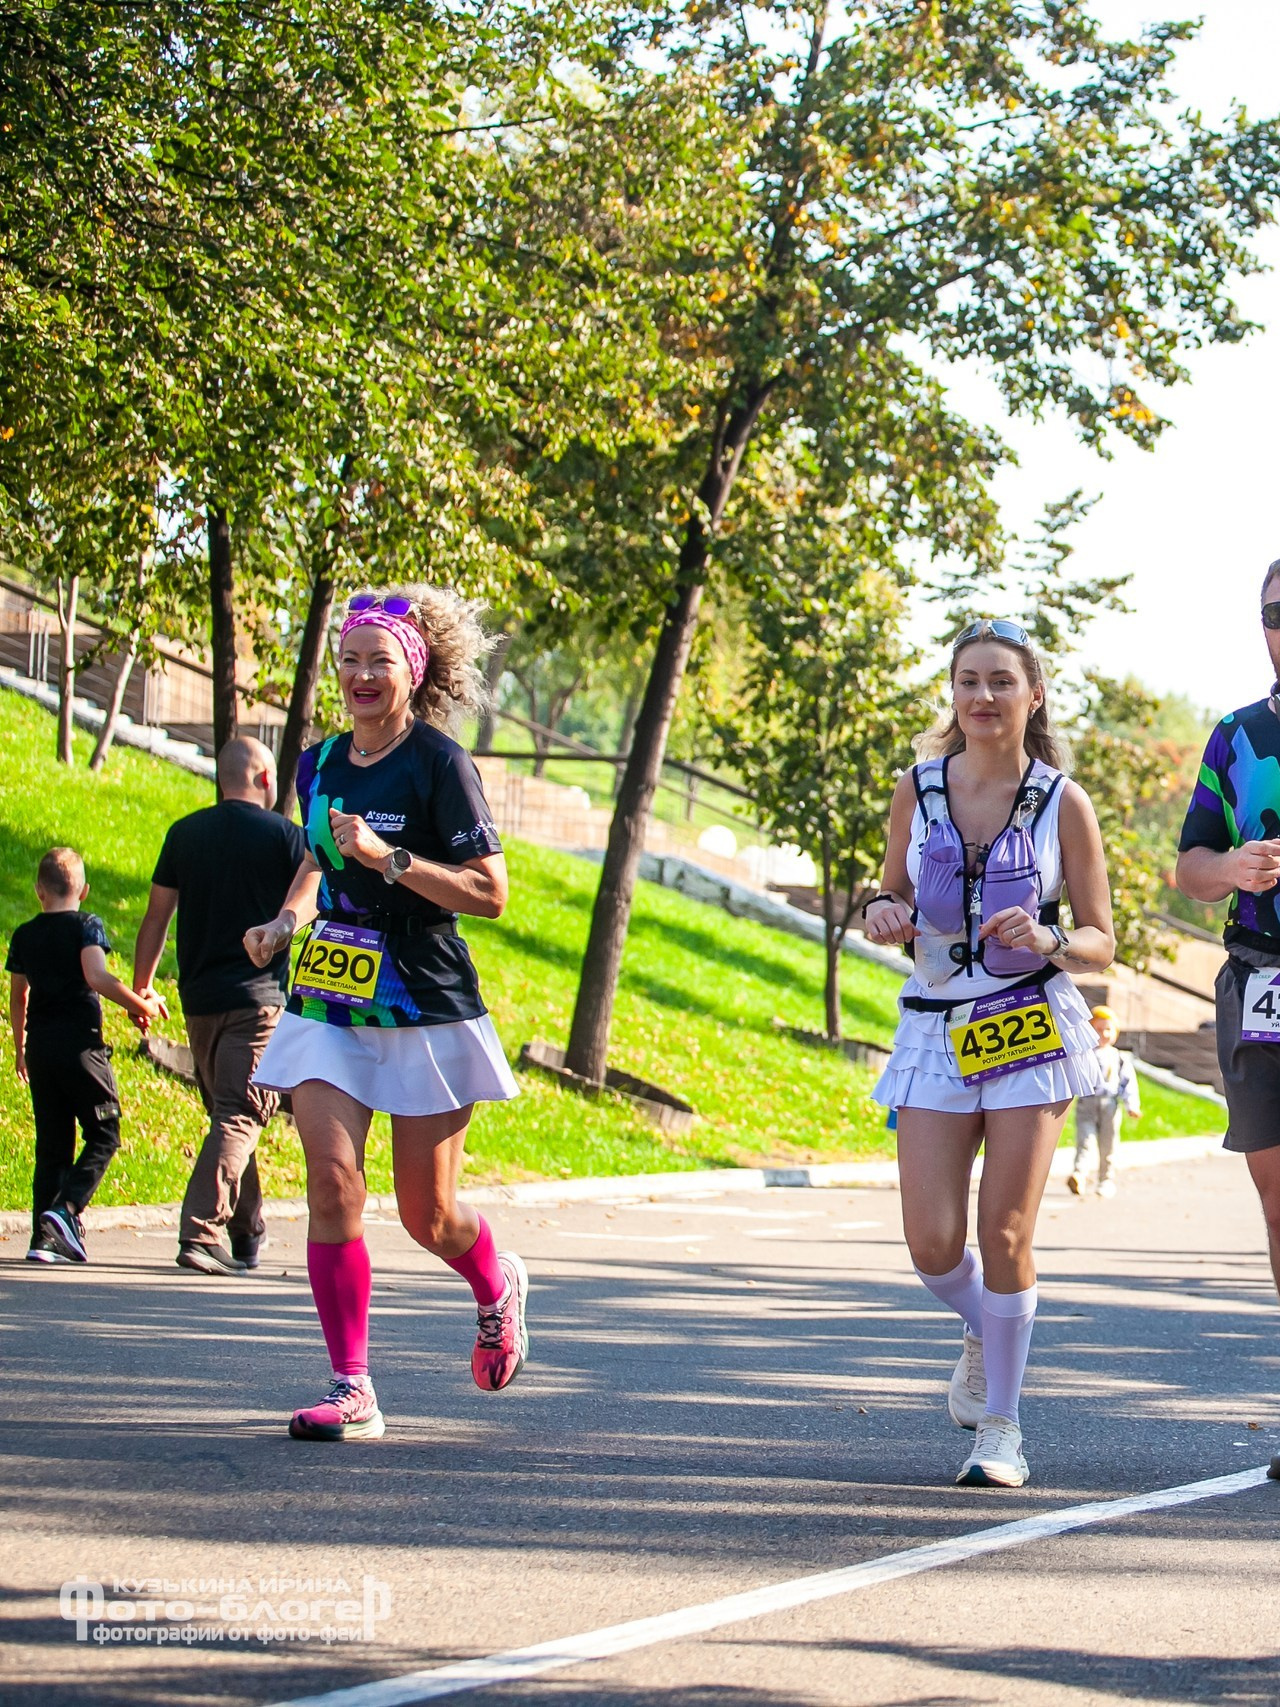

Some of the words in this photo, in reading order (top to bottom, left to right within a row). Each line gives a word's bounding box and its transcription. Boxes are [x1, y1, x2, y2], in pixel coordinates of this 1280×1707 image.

[301, 944, 375, 985] 4290
[326, 979, 357, 991] СВЕТЛАНА
[960, 1009, 1052, 1059] 4323
[982, 1053, 1006, 1065] РОТАРУ
[1007, 1044, 1037, 1057] ТАТЬЯНА
